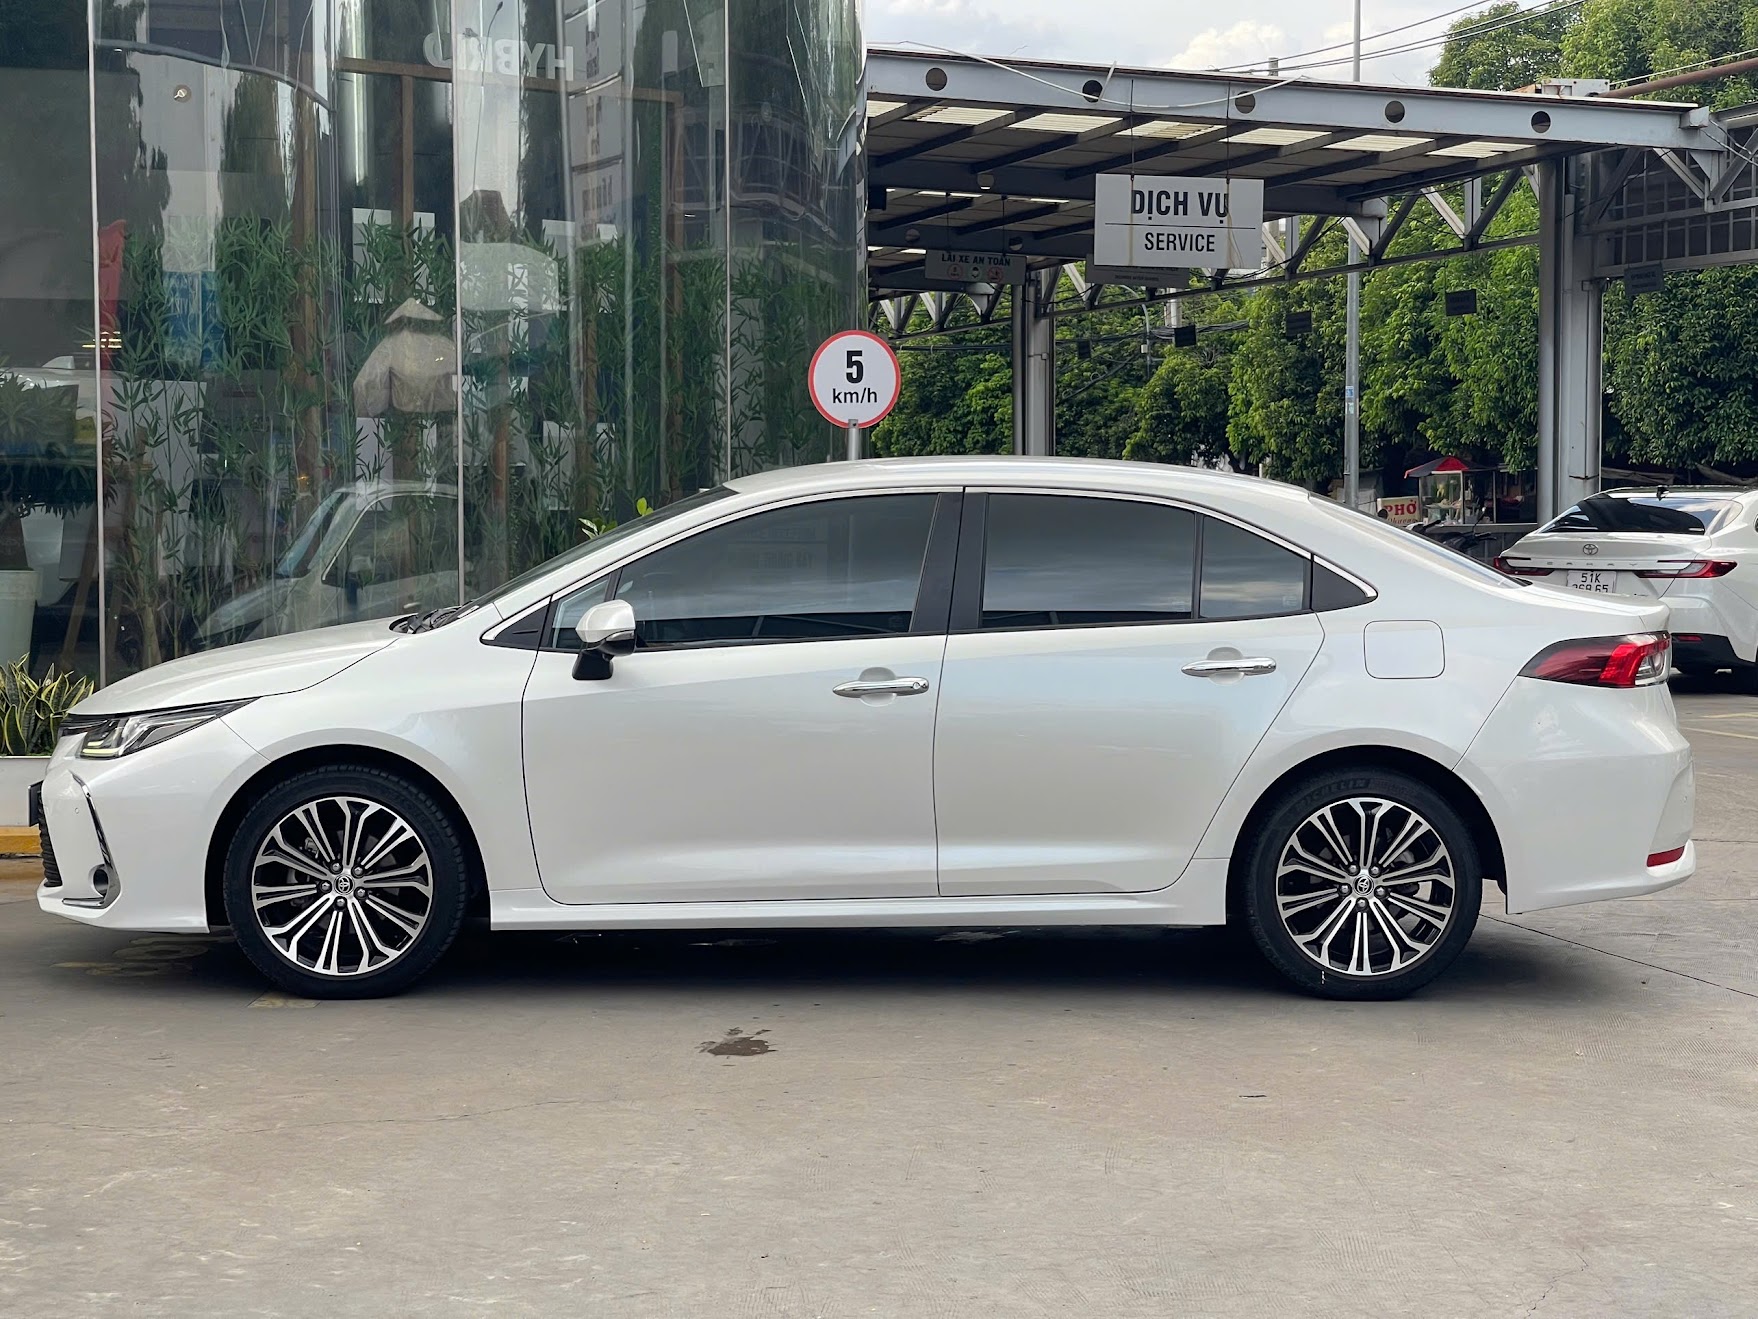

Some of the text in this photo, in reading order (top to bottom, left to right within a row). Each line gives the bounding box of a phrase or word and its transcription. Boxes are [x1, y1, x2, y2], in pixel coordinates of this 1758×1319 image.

[1132, 190, 1229, 224] DỊCH VỤ
[1145, 232, 1215, 252] SERVICE
[959, 255, 970, 263] XE
[973, 256, 985, 264] AN
[846, 350, 864, 384] 5
[833, 388, 877, 404] km/h
[1581, 573, 1601, 583] 51K
